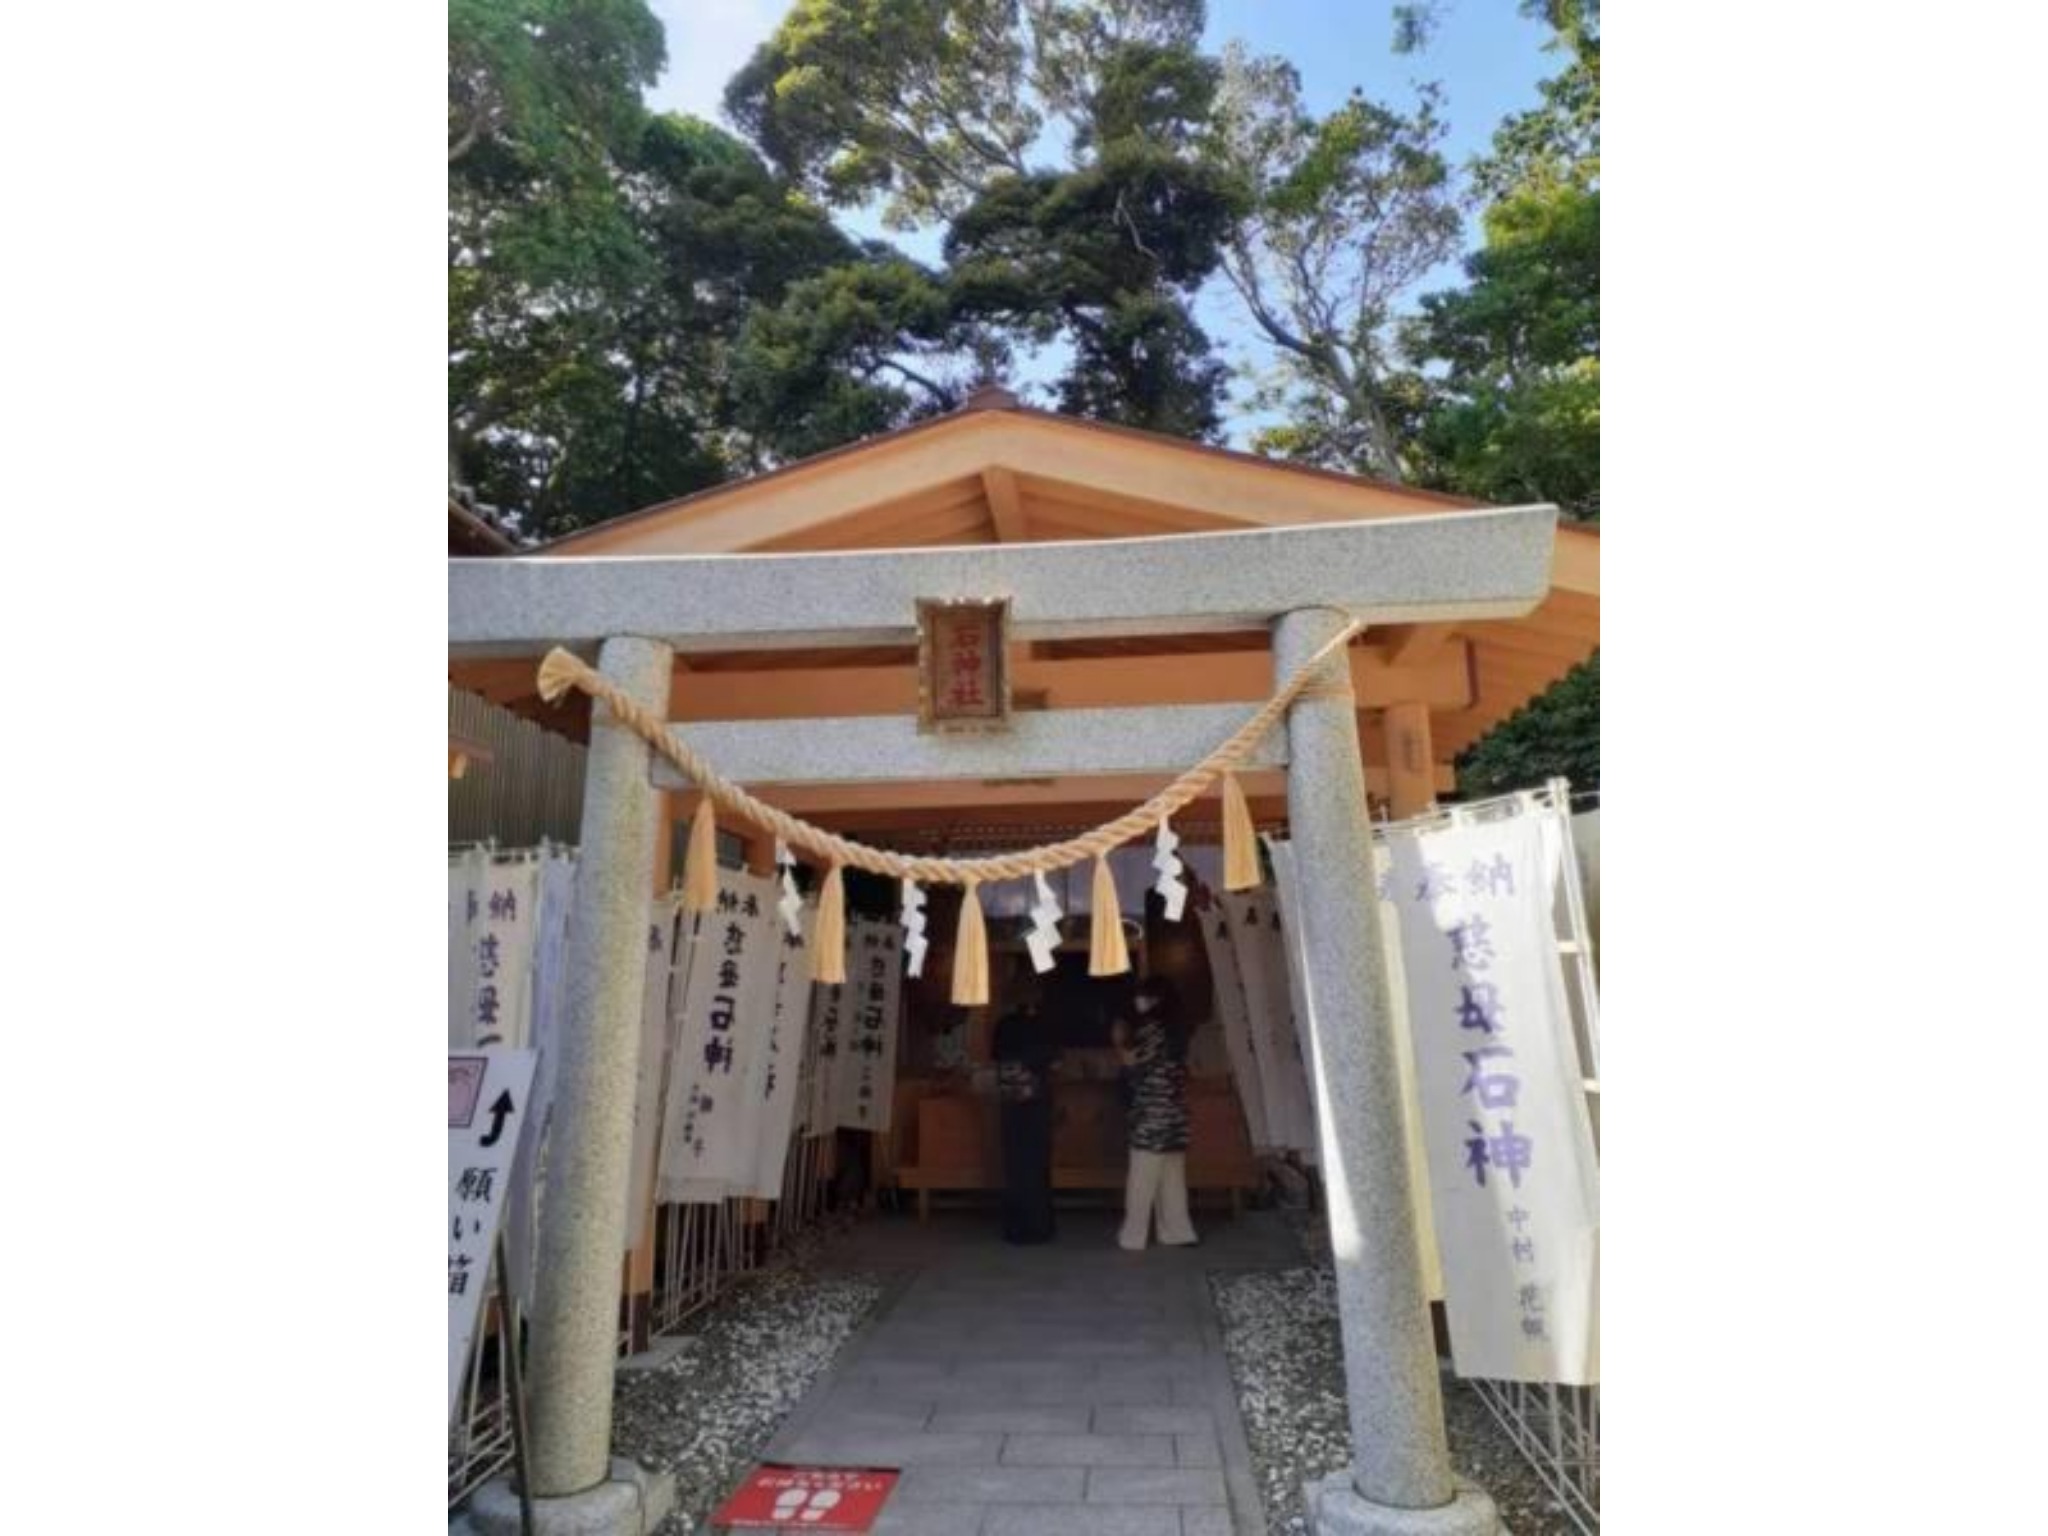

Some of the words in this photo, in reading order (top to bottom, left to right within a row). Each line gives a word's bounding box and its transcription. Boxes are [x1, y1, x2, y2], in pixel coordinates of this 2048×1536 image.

[950, 624, 984, 705] 石神社
[1414, 852, 1514, 902] 奉納
[1446, 913, 1533, 1189] 慈母石神
